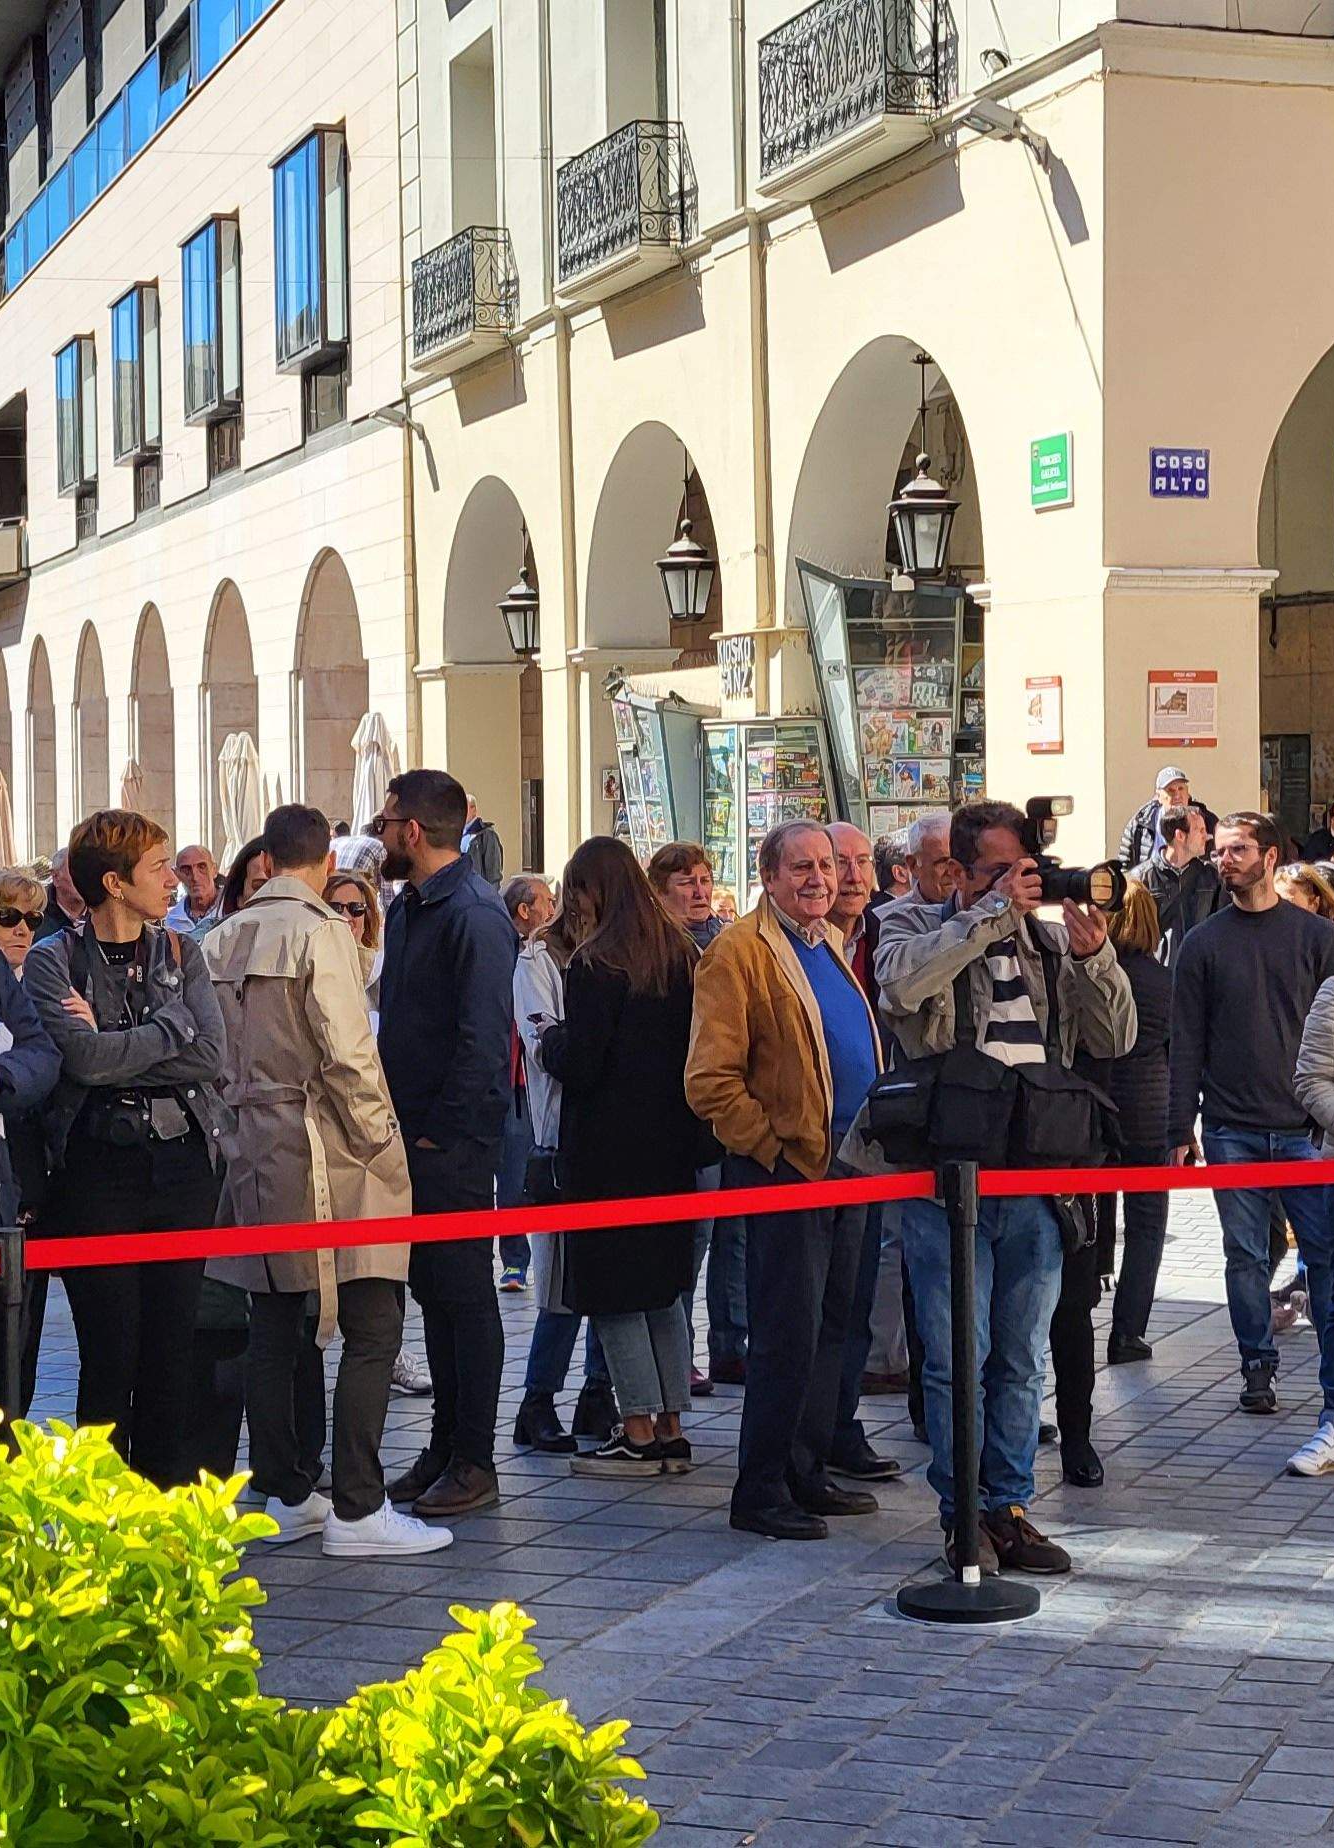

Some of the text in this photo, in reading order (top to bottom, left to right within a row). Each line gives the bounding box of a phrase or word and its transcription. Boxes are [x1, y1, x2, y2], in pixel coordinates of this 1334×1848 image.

[1155, 455, 1206, 470] COSO
[1155, 477, 1206, 491] ALTO
[716, 635, 752, 665] KIOSKO
[721, 666, 750, 696] SANZ
